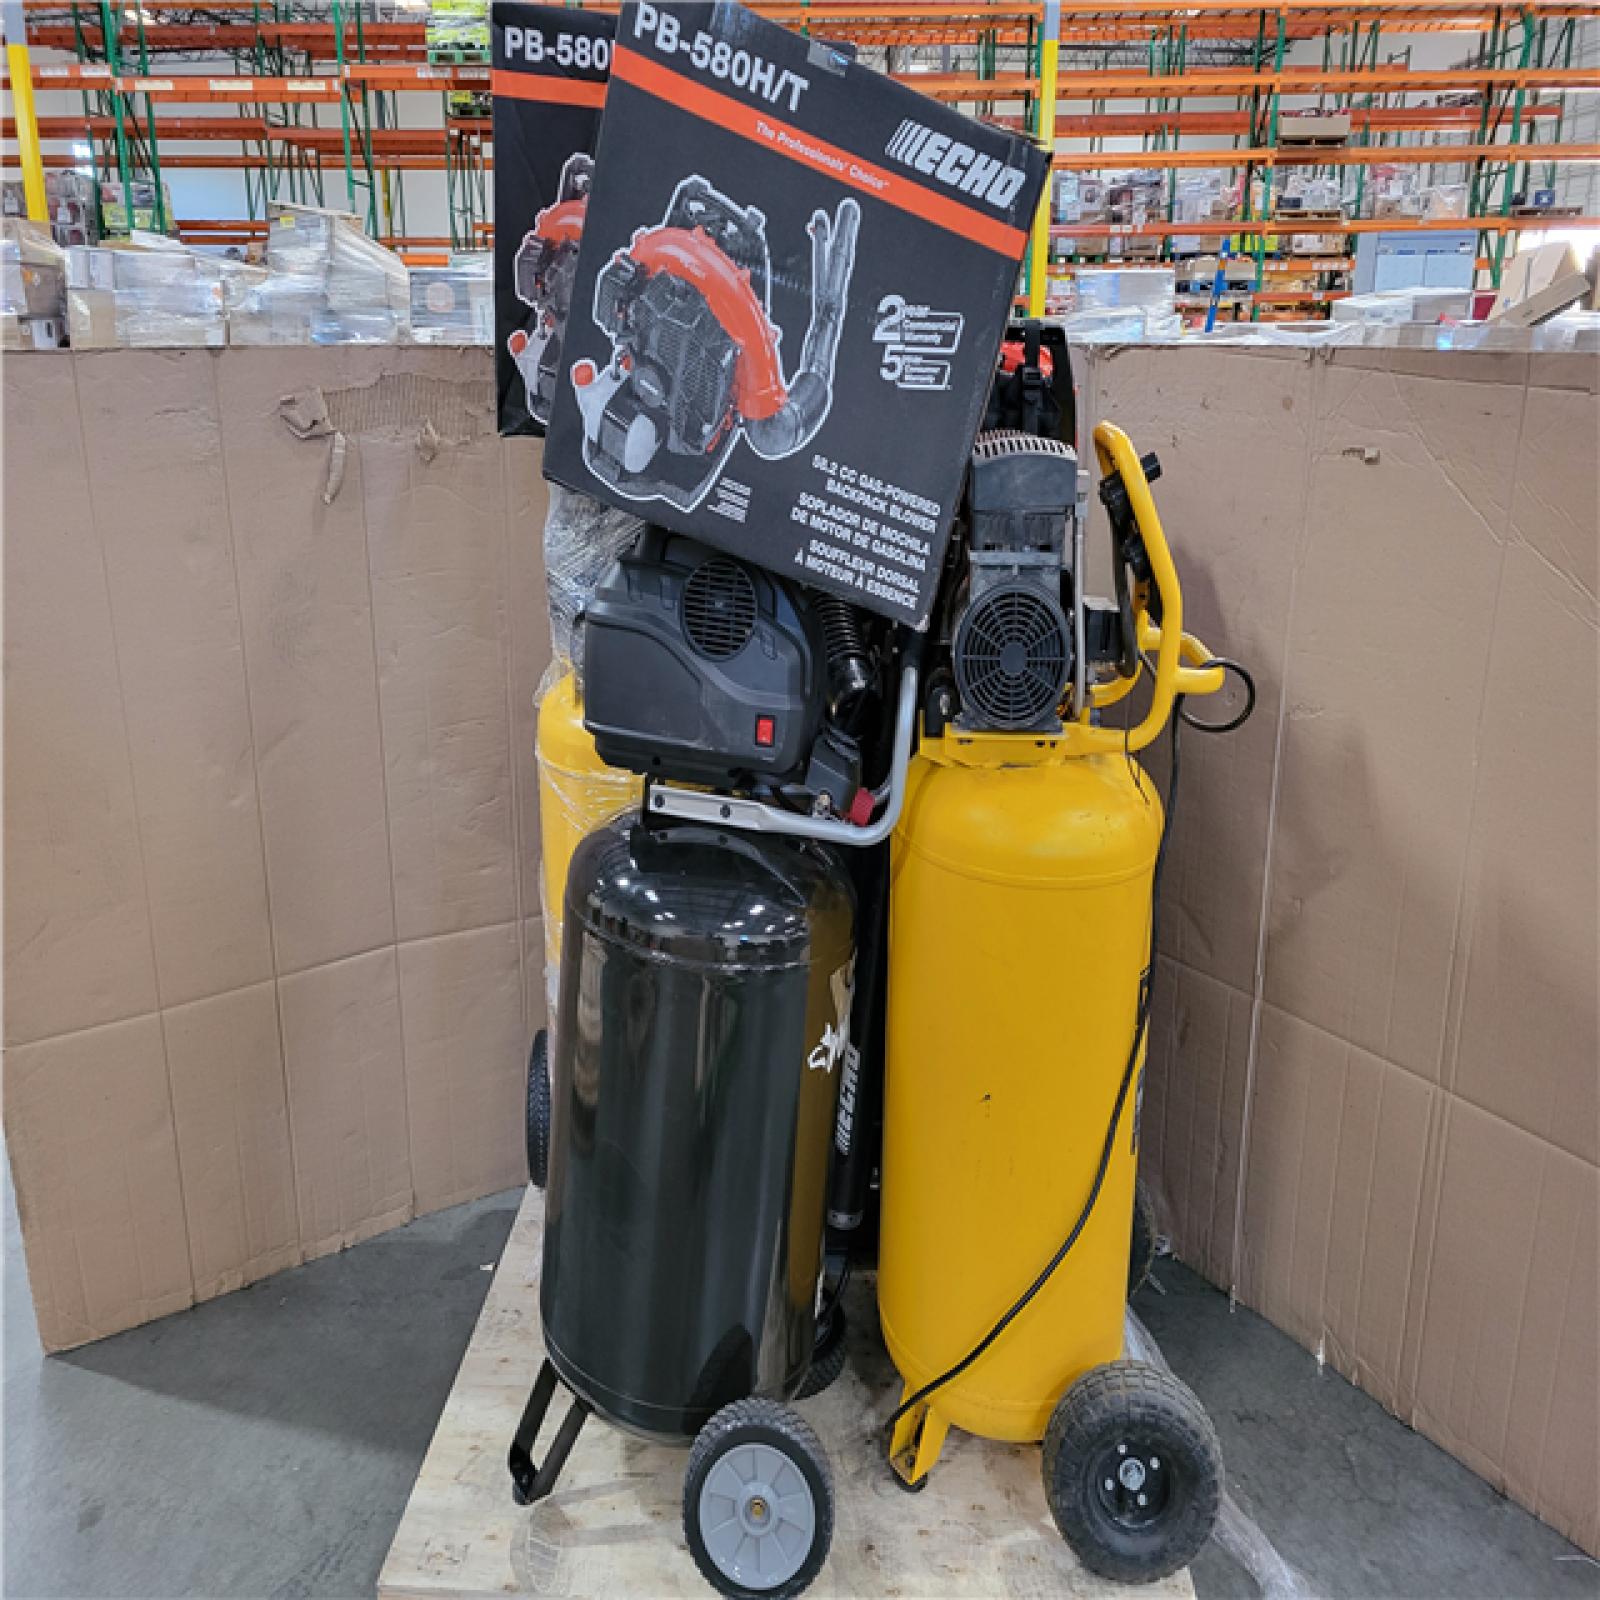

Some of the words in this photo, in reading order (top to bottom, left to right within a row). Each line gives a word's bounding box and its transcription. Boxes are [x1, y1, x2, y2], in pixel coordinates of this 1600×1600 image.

[504, 24, 616, 71] PB-580
[633, 0, 809, 112] PB-580H/T
[913, 130, 1026, 209] ECHO
